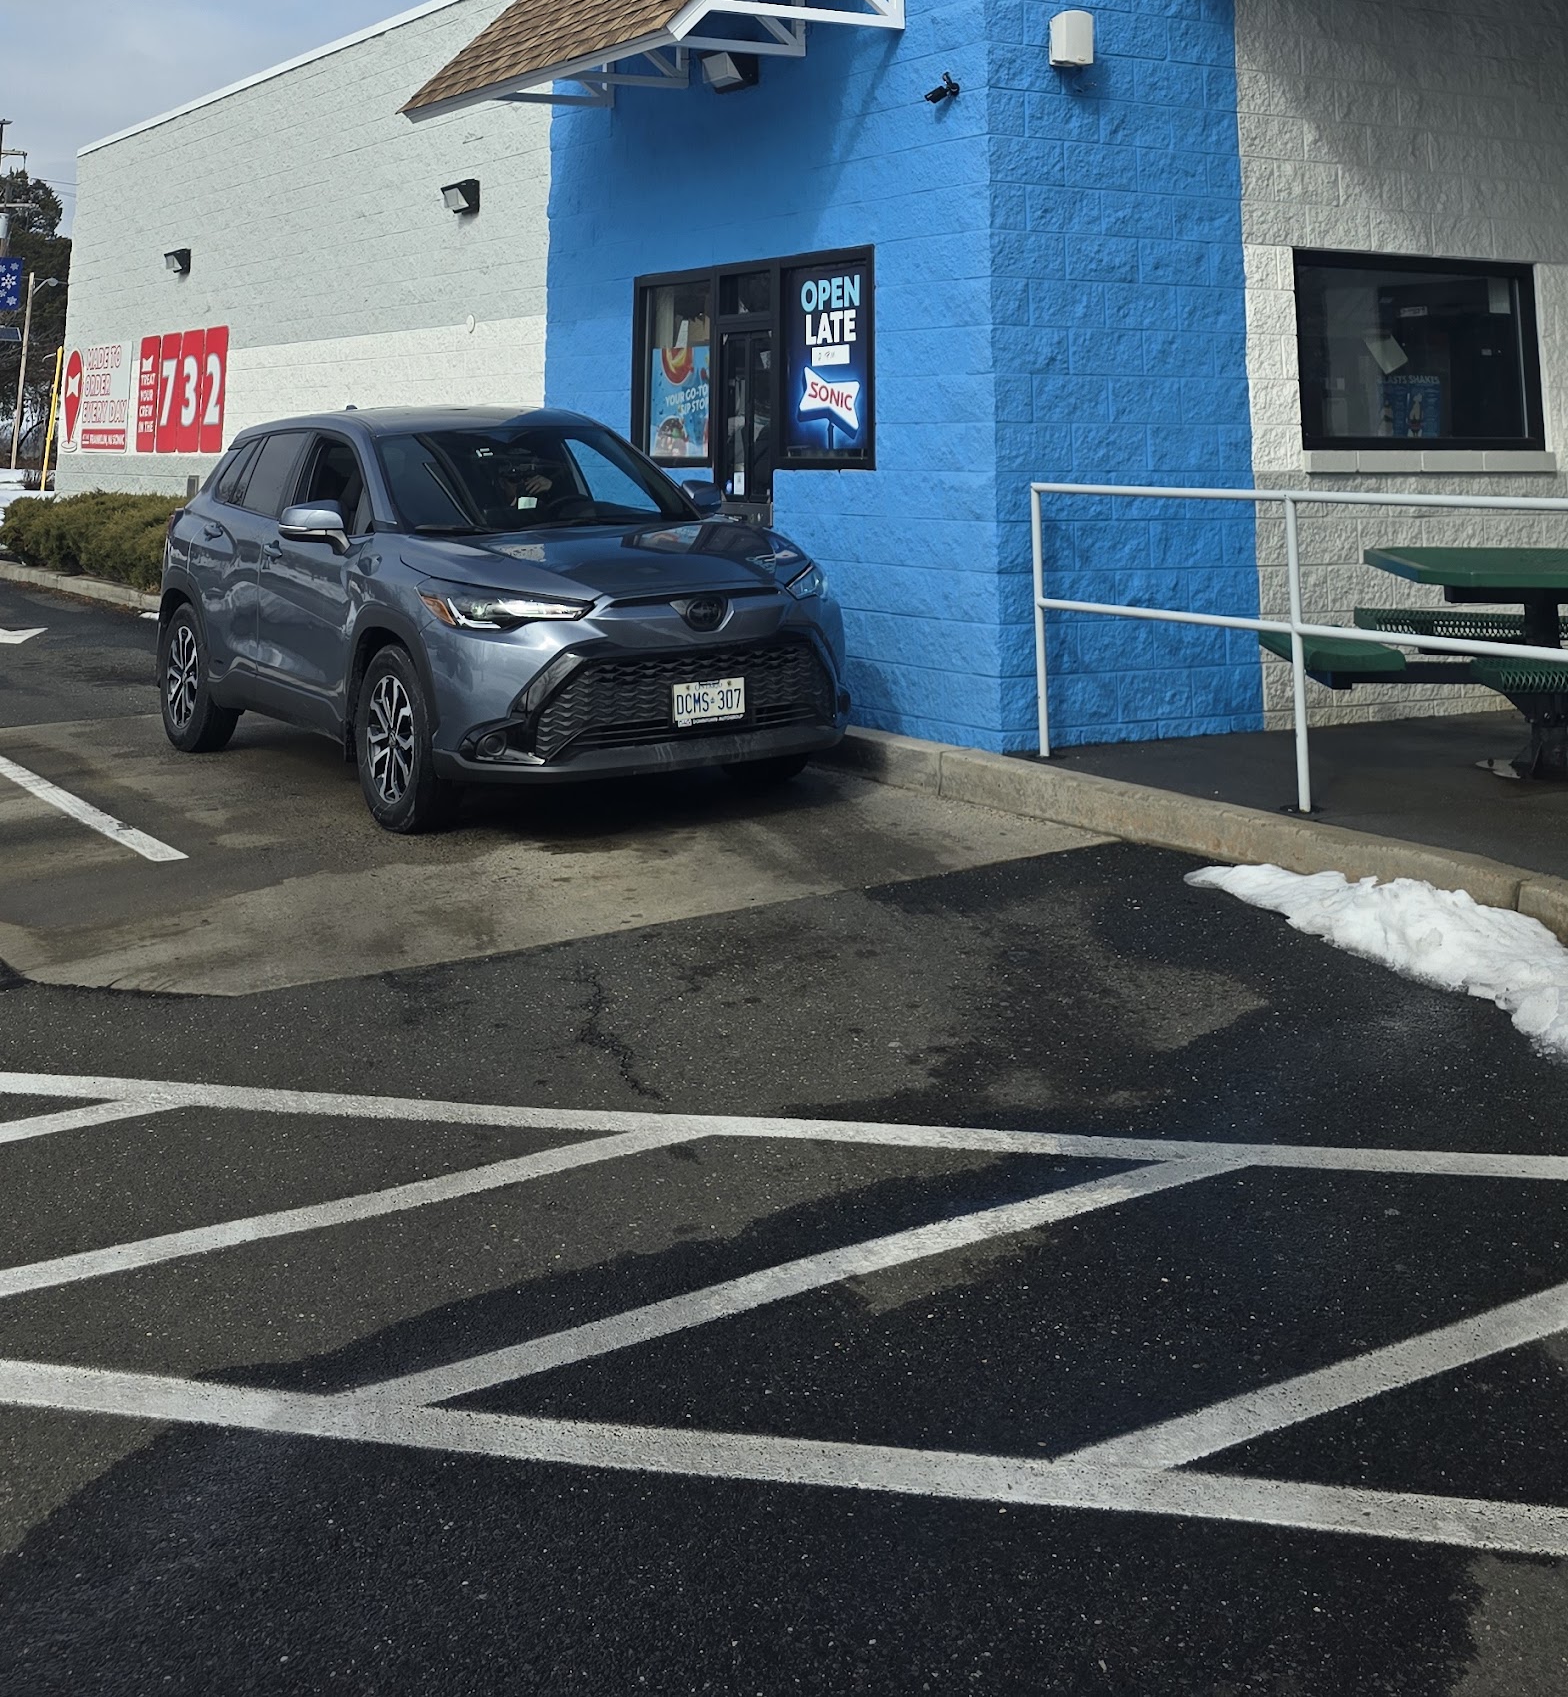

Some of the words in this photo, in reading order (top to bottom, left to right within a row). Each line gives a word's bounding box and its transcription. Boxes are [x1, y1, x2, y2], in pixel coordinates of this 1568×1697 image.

[801, 274, 861, 313] OPEN
[805, 309, 857, 346] LATE
[86, 346, 110, 370] MADE
[110, 345, 122, 368] TO
[84, 373, 112, 397] ORDER
[141, 373, 156, 386] TREAT
[159, 352, 221, 427] 732
[1408, 375, 1441, 385] SHAKES
[140, 389, 154, 402] YOUR
[665, 391, 685, 407] YOUR
[685, 383, 709, 401] GO-TO
[808, 381, 853, 412] SONIC
[82, 400, 109, 424] EVERY
[109, 399, 128, 423] DAY
[139, 405, 154, 417] CREW
[680, 403, 691, 416] SIP
[138, 421, 144, 433] IN
[144, 420, 154, 433] THE
[676, 692, 709, 715] DCMS
[717, 688, 741, 711] 307
